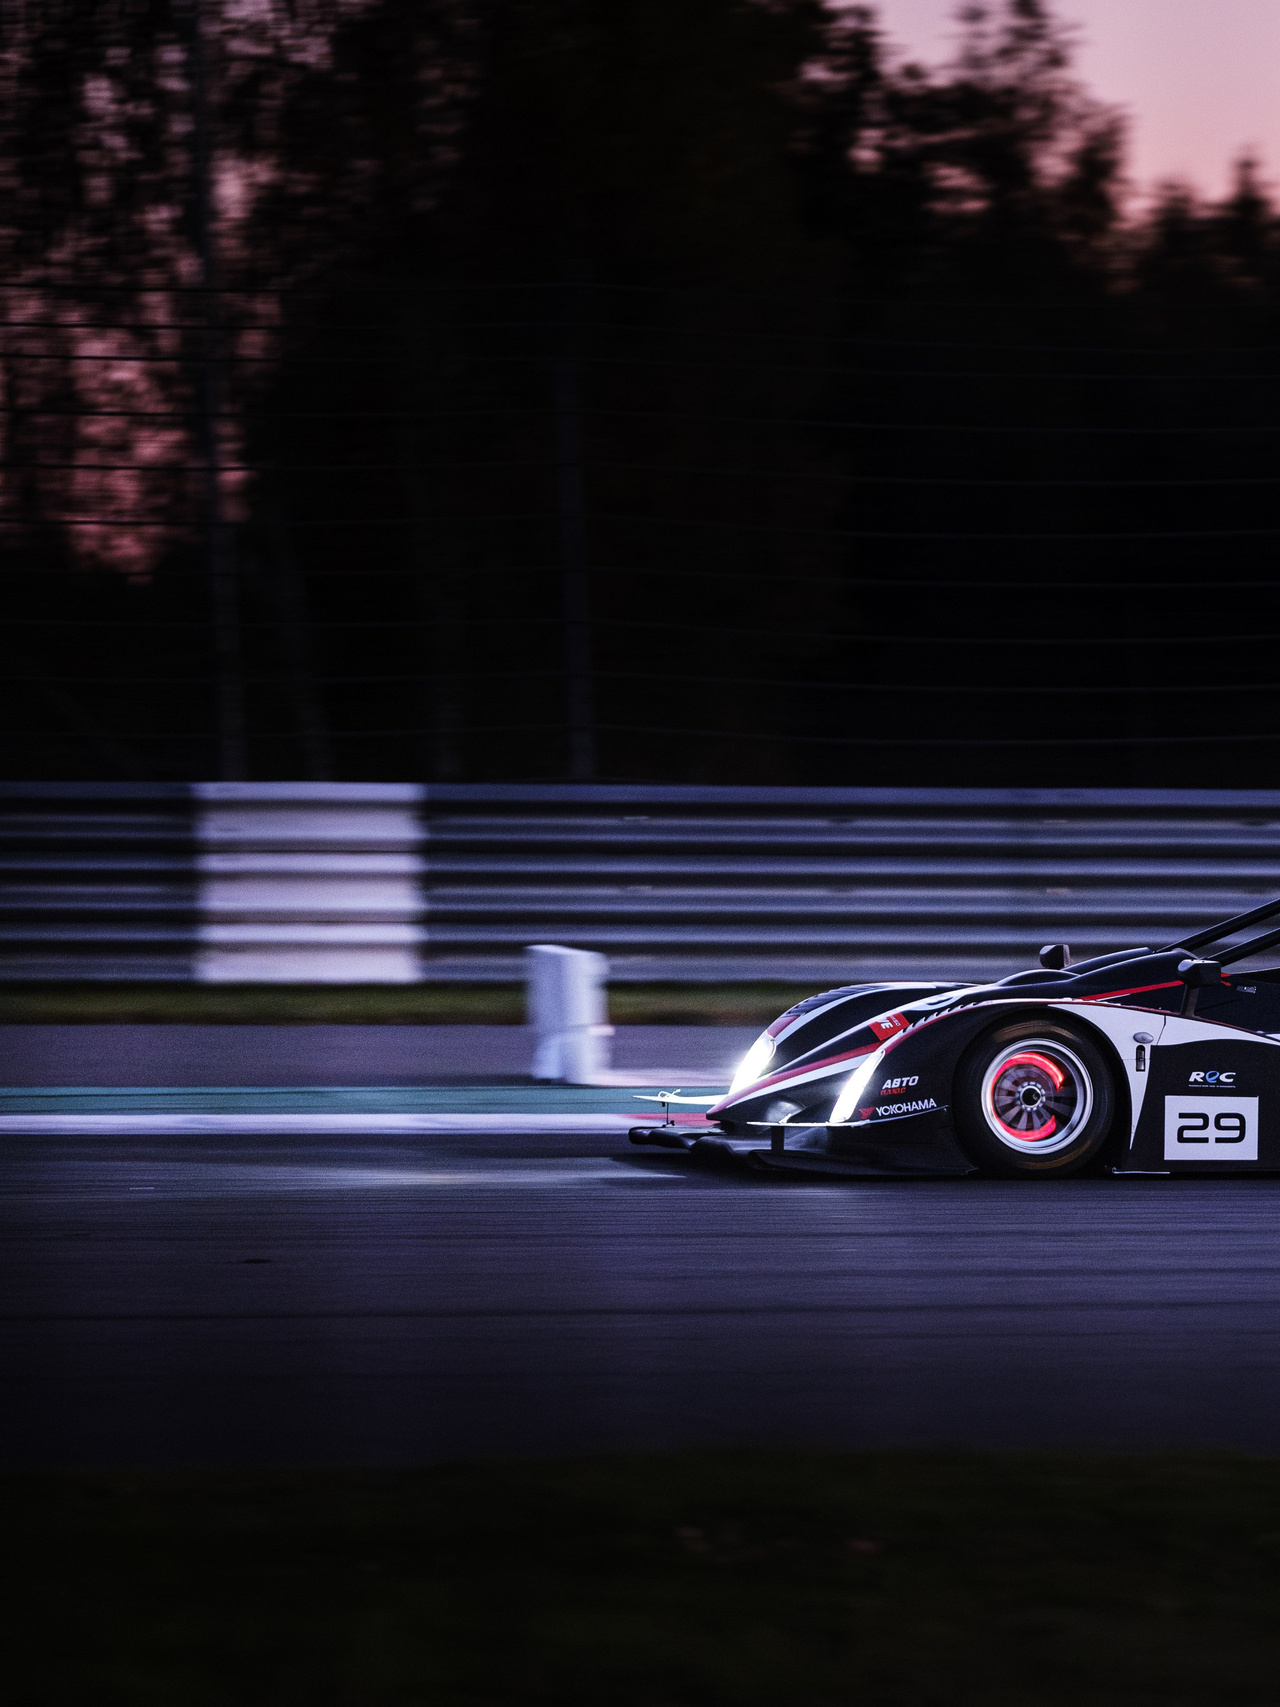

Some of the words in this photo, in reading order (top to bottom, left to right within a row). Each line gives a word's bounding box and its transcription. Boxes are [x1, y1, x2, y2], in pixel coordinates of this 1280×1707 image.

[882, 1076, 919, 1089] АВТО
[876, 1098, 937, 1116] YOKOHAMA
[1177, 1112, 1246, 1144] 29
